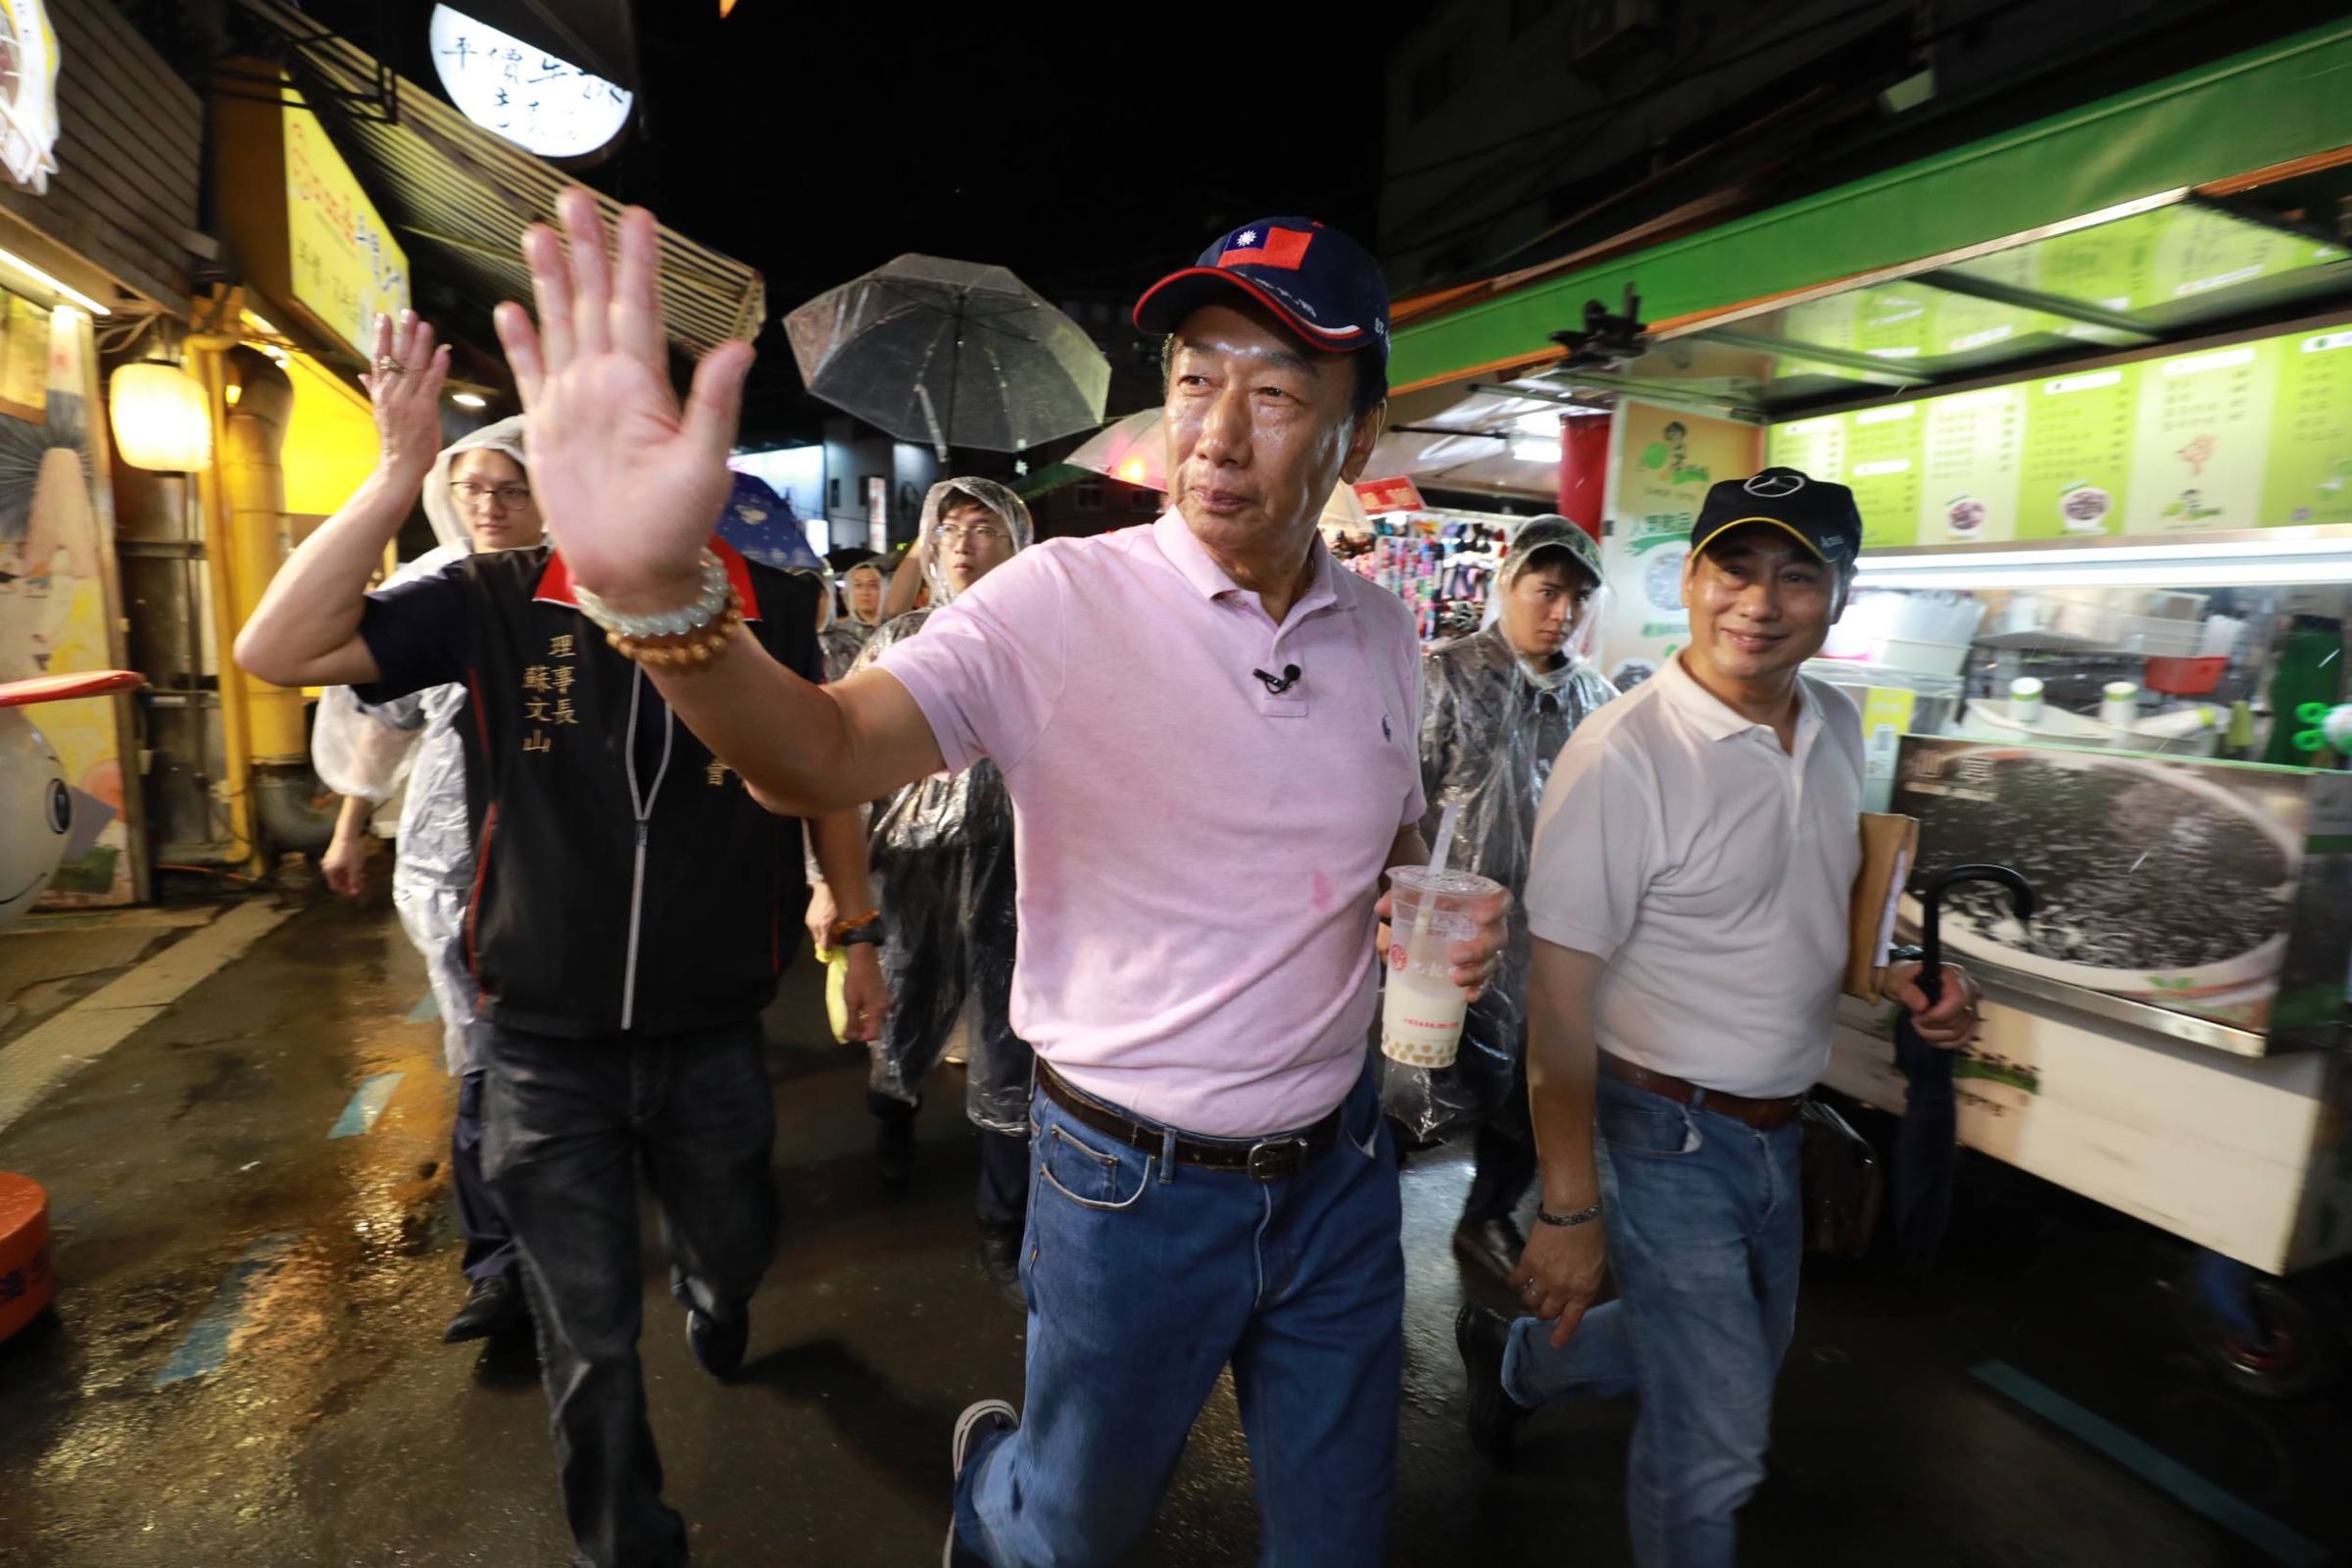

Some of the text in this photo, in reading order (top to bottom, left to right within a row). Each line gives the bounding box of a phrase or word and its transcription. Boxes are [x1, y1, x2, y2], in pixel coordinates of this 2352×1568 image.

[522, 663, 555, 754] 蘇文山
[548, 634, 580, 725] 理事長
